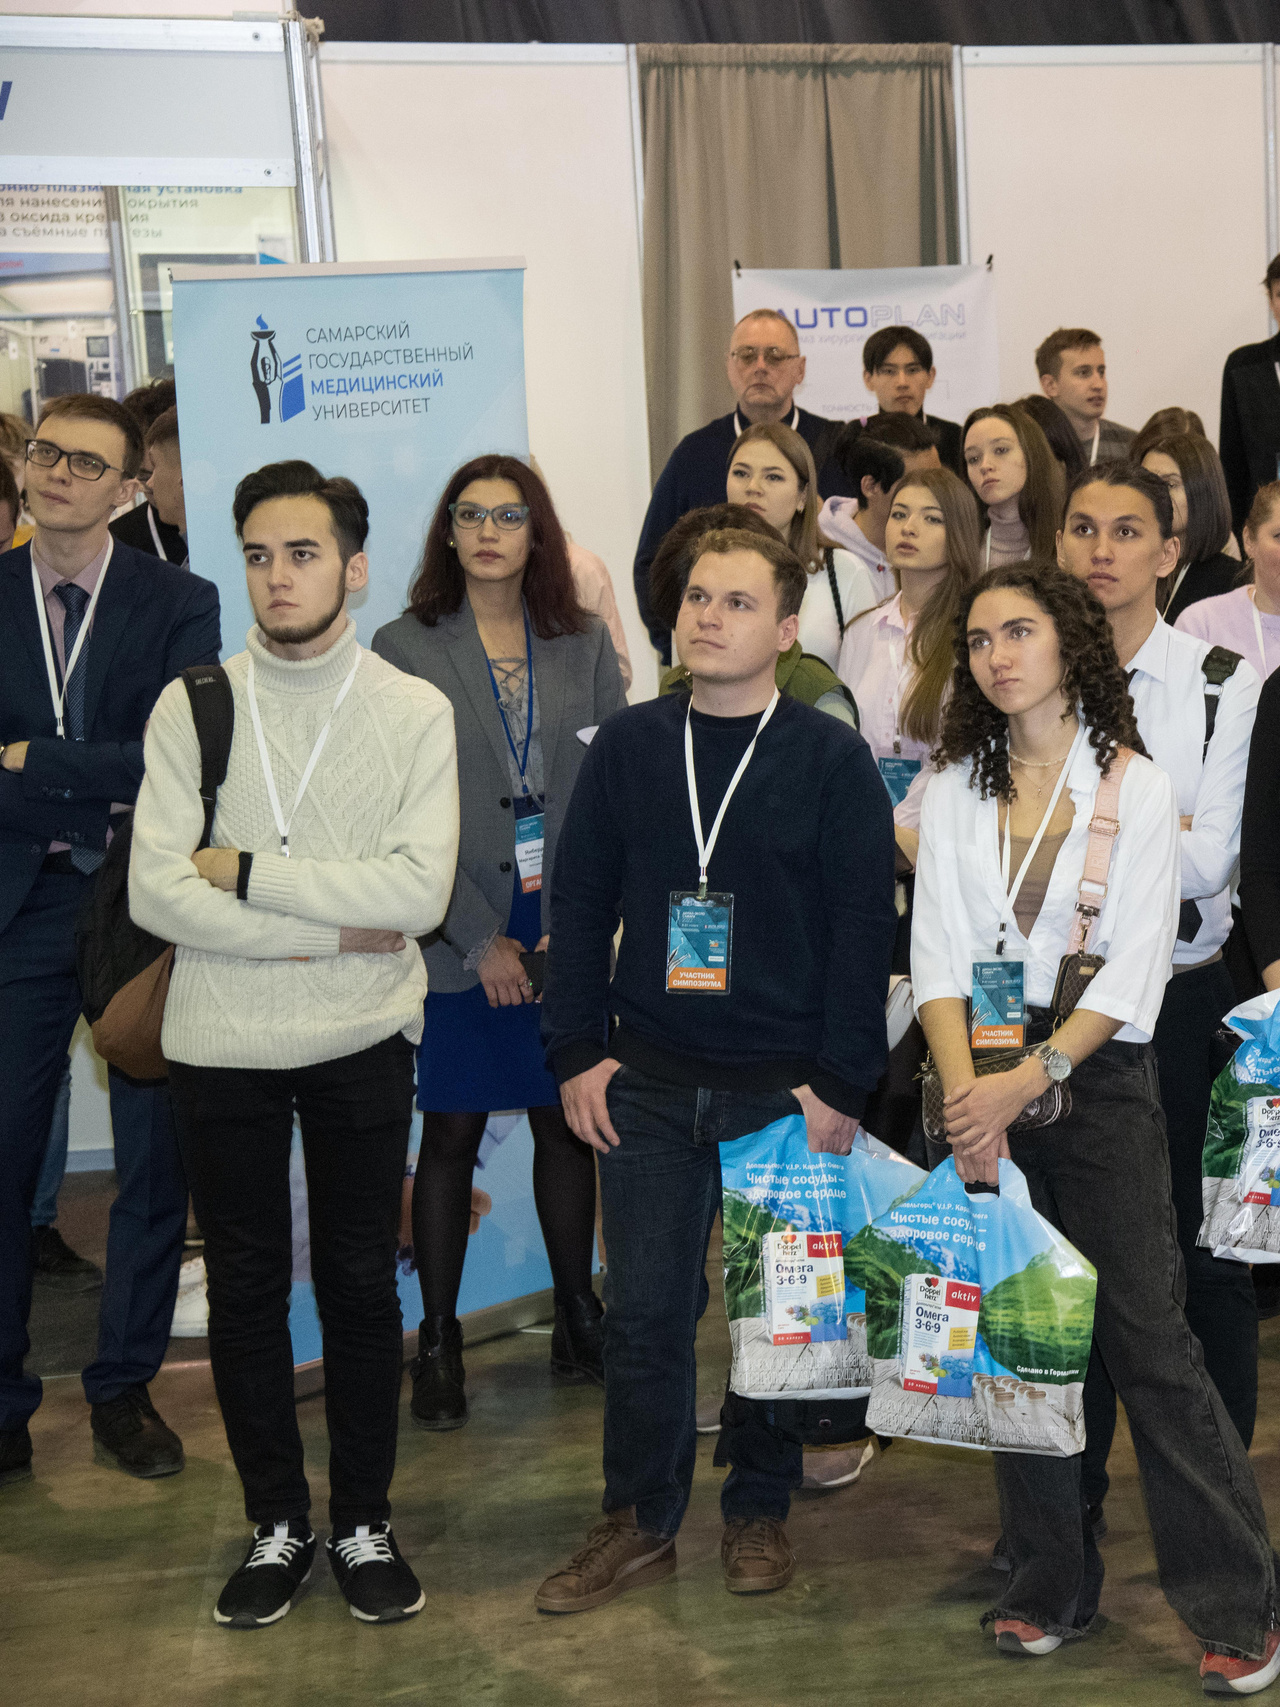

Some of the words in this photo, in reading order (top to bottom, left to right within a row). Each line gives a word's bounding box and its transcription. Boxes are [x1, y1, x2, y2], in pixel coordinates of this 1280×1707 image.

[20, 196, 106, 208] нанесени
[127, 198, 199, 210] окрытия
[306, 320, 411, 344] САМАРСКИЙ
[308, 341, 474, 370] ГОСУДАРСТВЕННЫЙ
[311, 368, 444, 396] МЕДИЦИНСКИЙ
[312, 397, 431, 422] УНИВЕРСИТЕТ
[672, 979, 722, 987] СИМПОЗИУМА
[975, 1038, 1020, 1046] СИМПОЗИУМА
[746, 1172, 789, 1185] Чистые
[792, 1174, 838, 1186] сосуды
[746, 1189, 802, 1200] здоровое
[805, 1188, 847, 1200] сердце
[890, 1211, 940, 1225] Чистые
[943, 1215, 977, 1234] сосу
[777, 1243, 802, 1251] Doppel
[812, 1241, 839, 1250] aktiv
[890, 1228, 950, 1241] здоровое
[952, 1233, 987, 1252] сере
[775, 1263, 814, 1274] Омега
[776, 1274, 807, 1285] 3-6-9
[919, 1285, 941, 1297] Doppel
[951, 1290, 977, 1302] aktiv
[924, 1293, 937, 1301] herz
[915, 1306, 949, 1322] Омега
[915, 1318, 941, 1334] 3-6-9
[1016, 1365, 1043, 1374] Сделано
